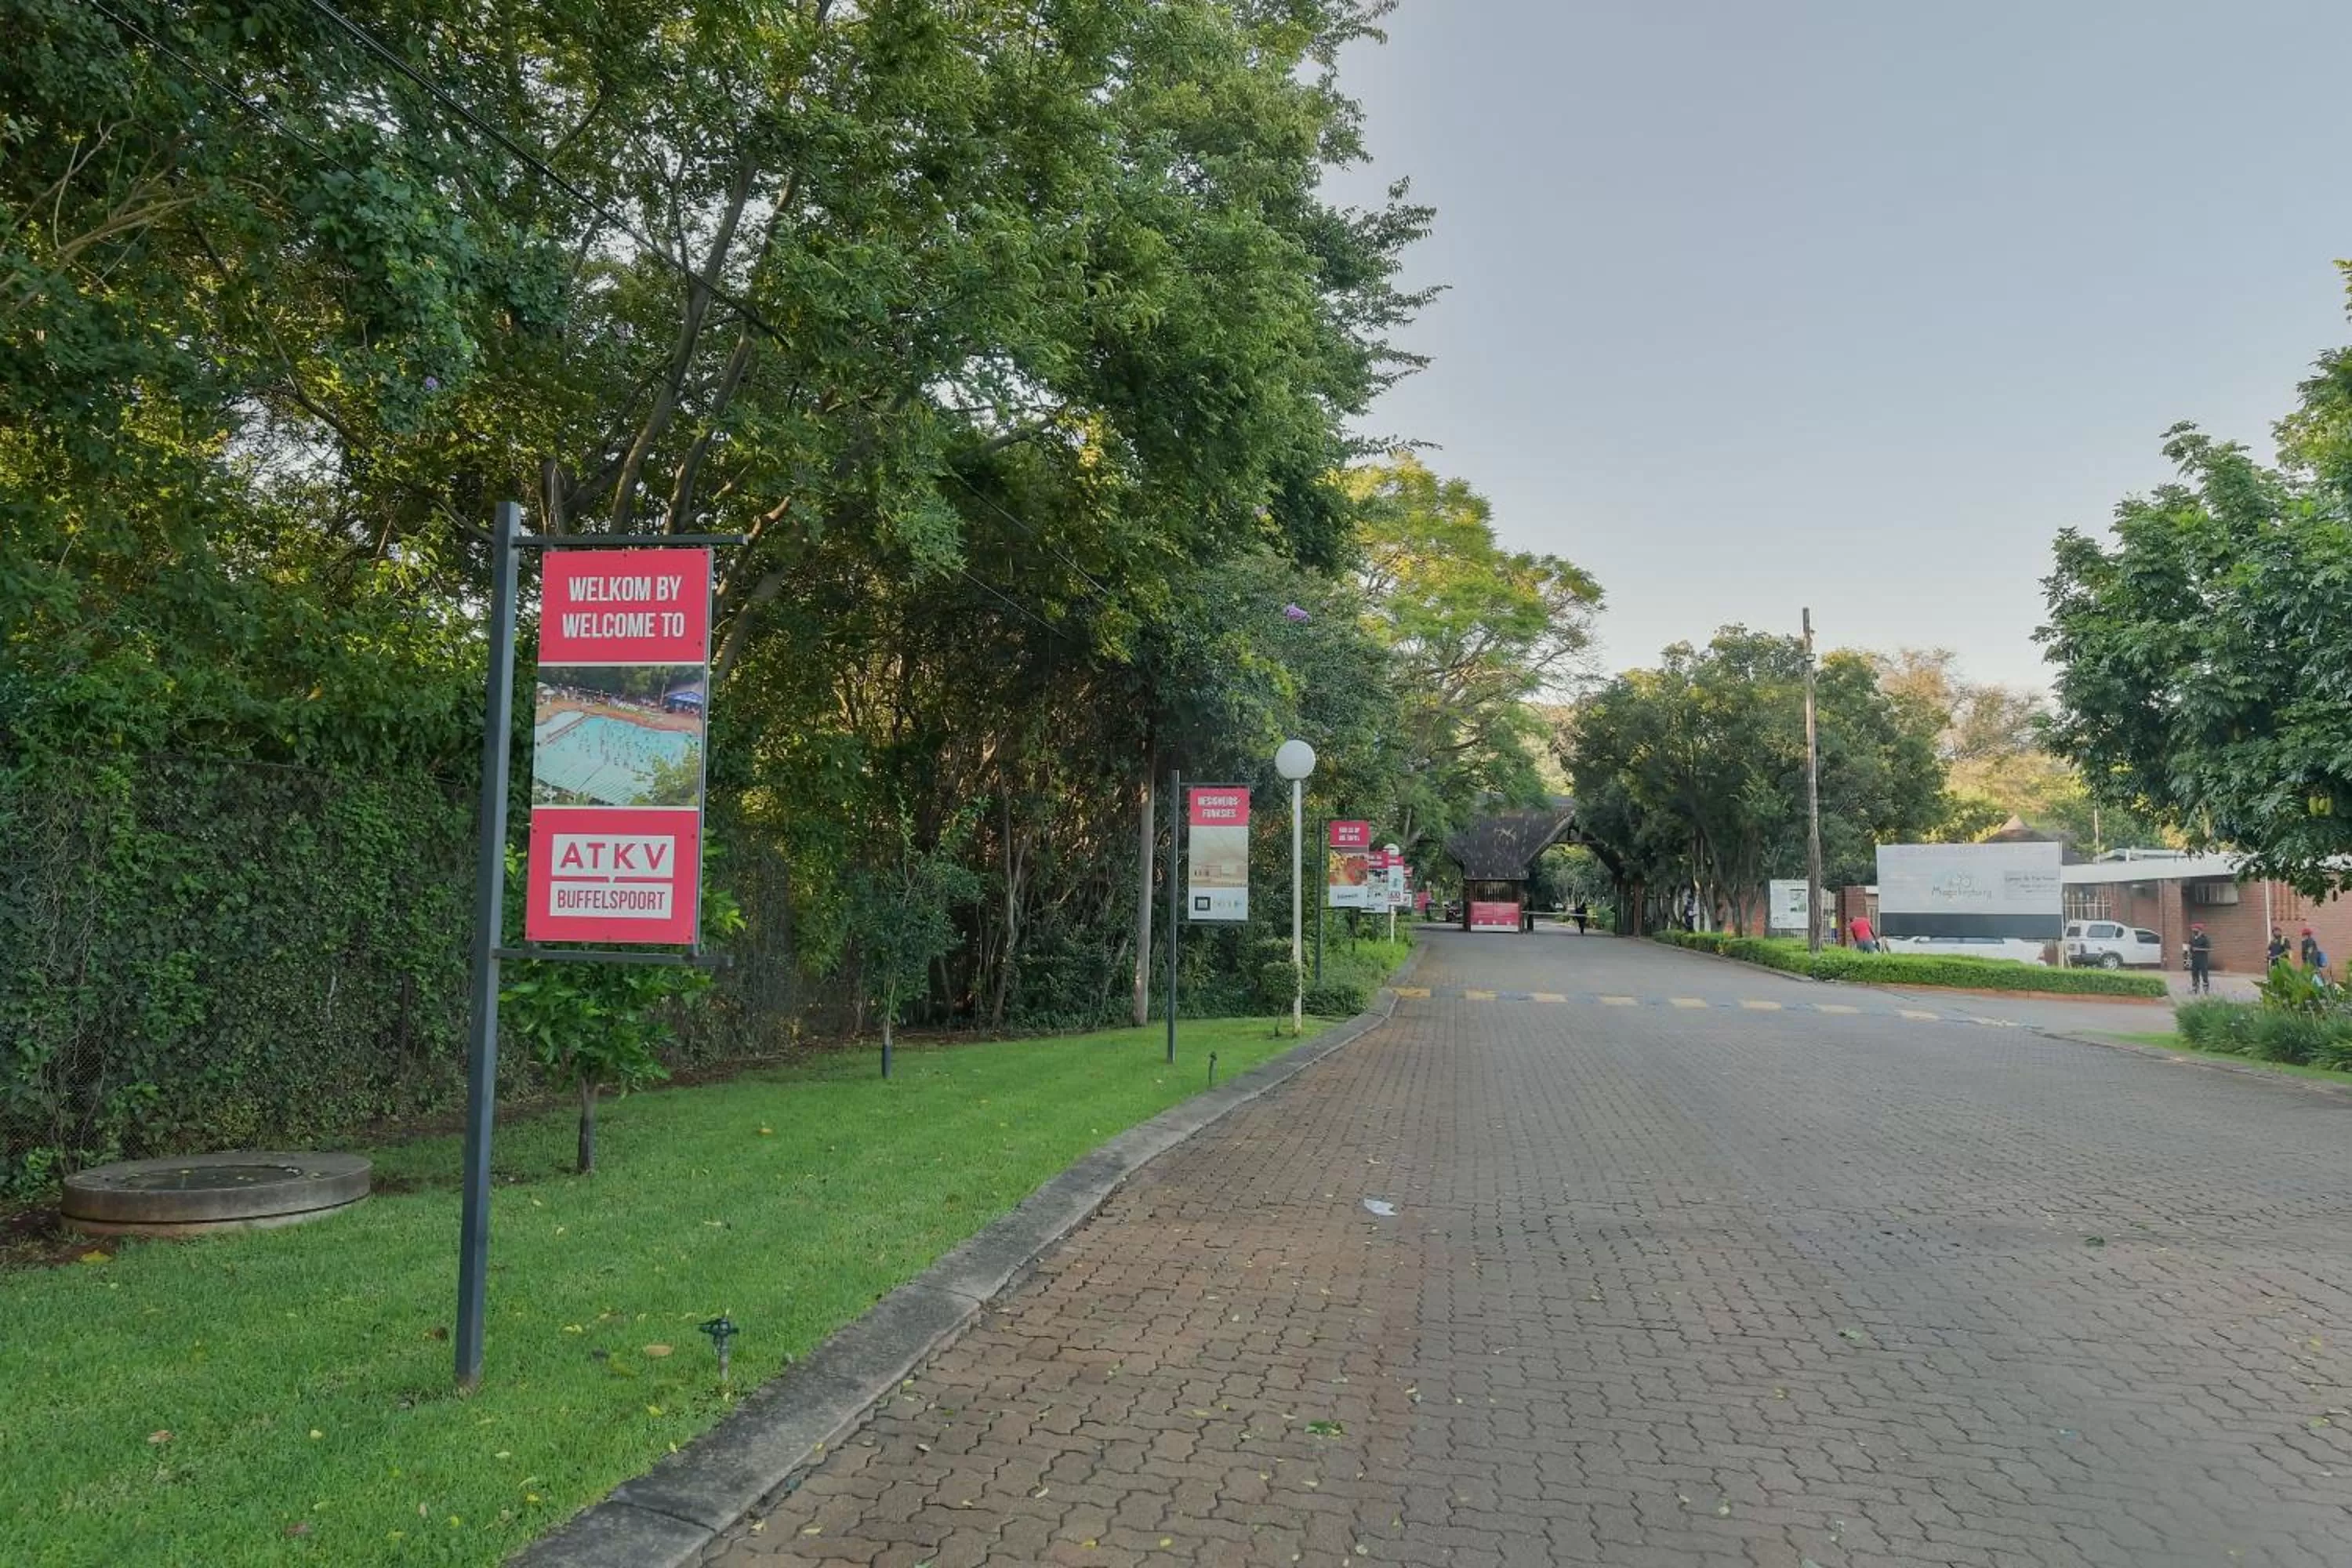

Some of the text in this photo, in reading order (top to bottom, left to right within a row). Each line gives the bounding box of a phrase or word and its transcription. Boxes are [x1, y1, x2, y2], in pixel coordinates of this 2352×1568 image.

[568, 575, 682, 602] WELKOM BY
[562, 612, 684, 639] WELCOME TO
[559, 841, 668, 870] ATKV
[557, 888, 666, 911] BUFFELSPOORT
